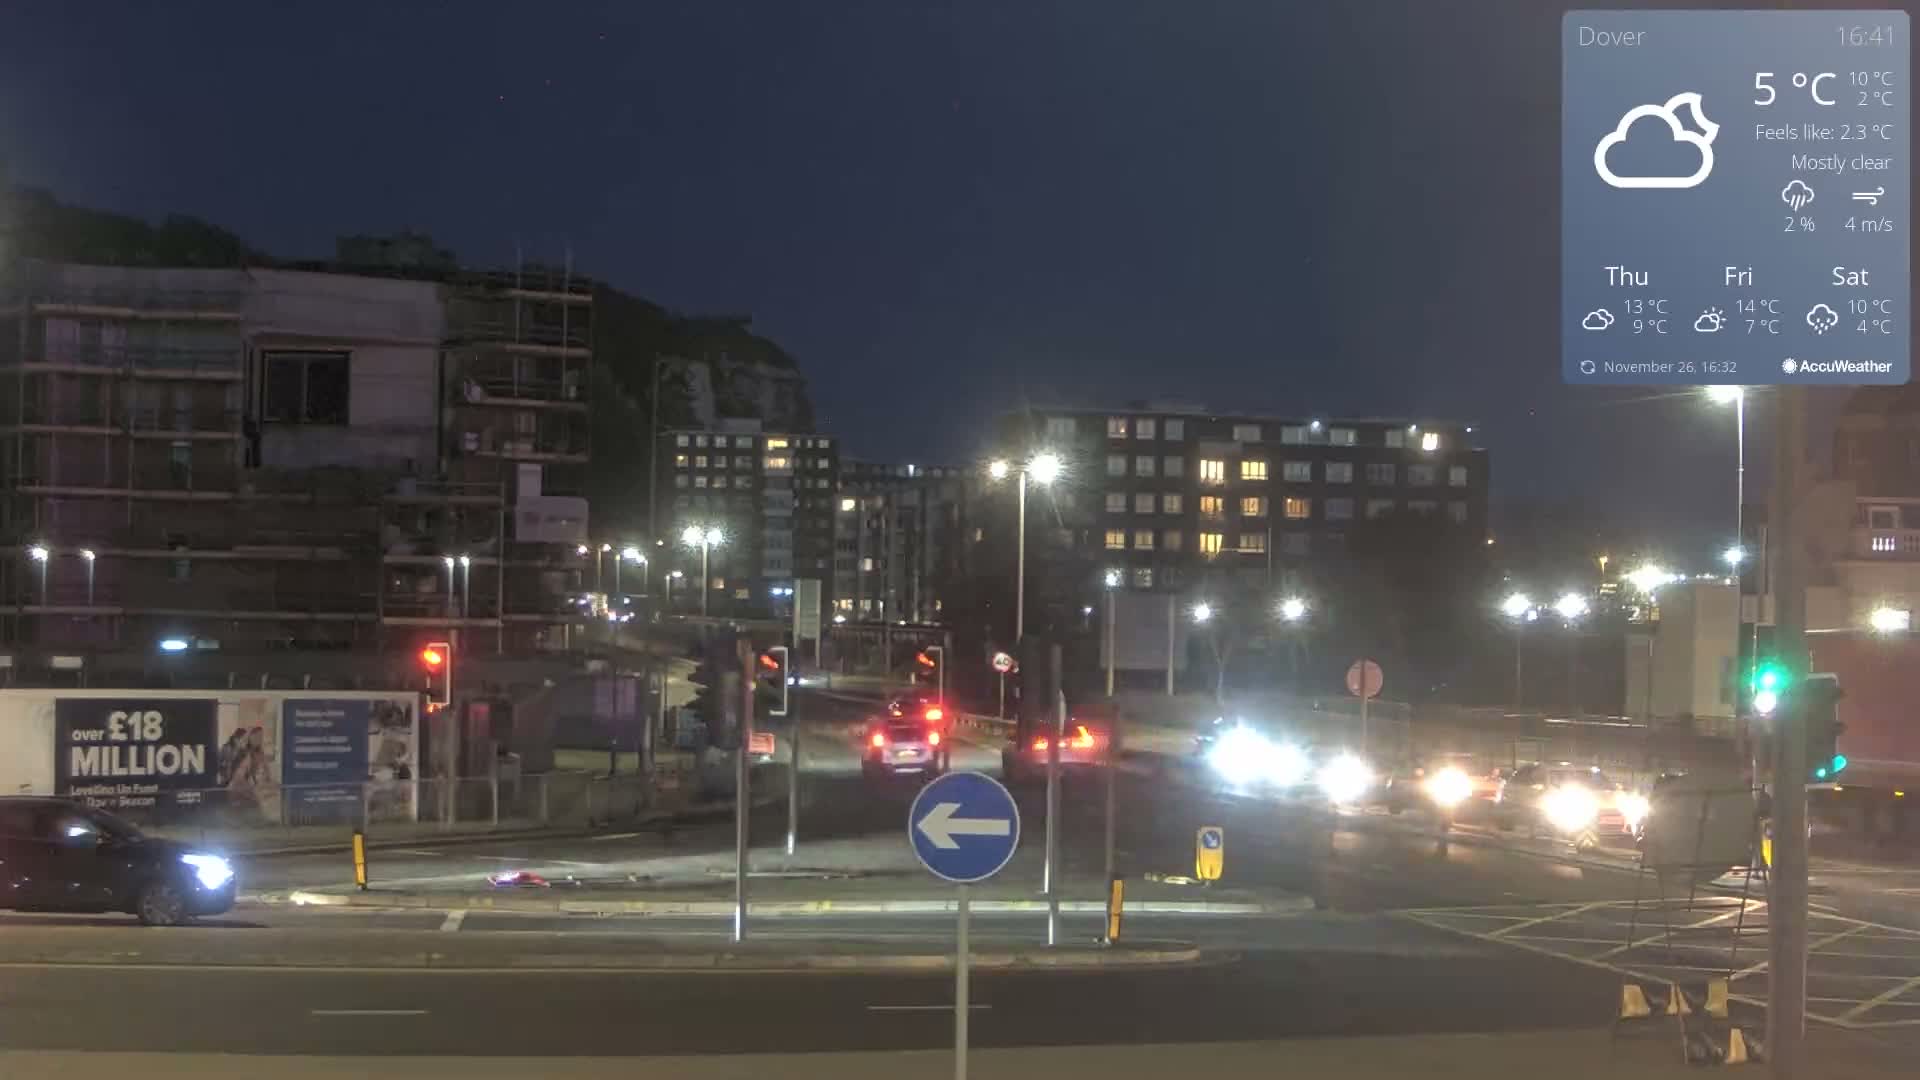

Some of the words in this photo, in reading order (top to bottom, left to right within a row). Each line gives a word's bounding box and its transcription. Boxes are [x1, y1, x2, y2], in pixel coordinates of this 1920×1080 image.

[72, 729, 104, 741] over
[109, 710, 163, 741] £18
[71, 744, 205, 776] MILLION
